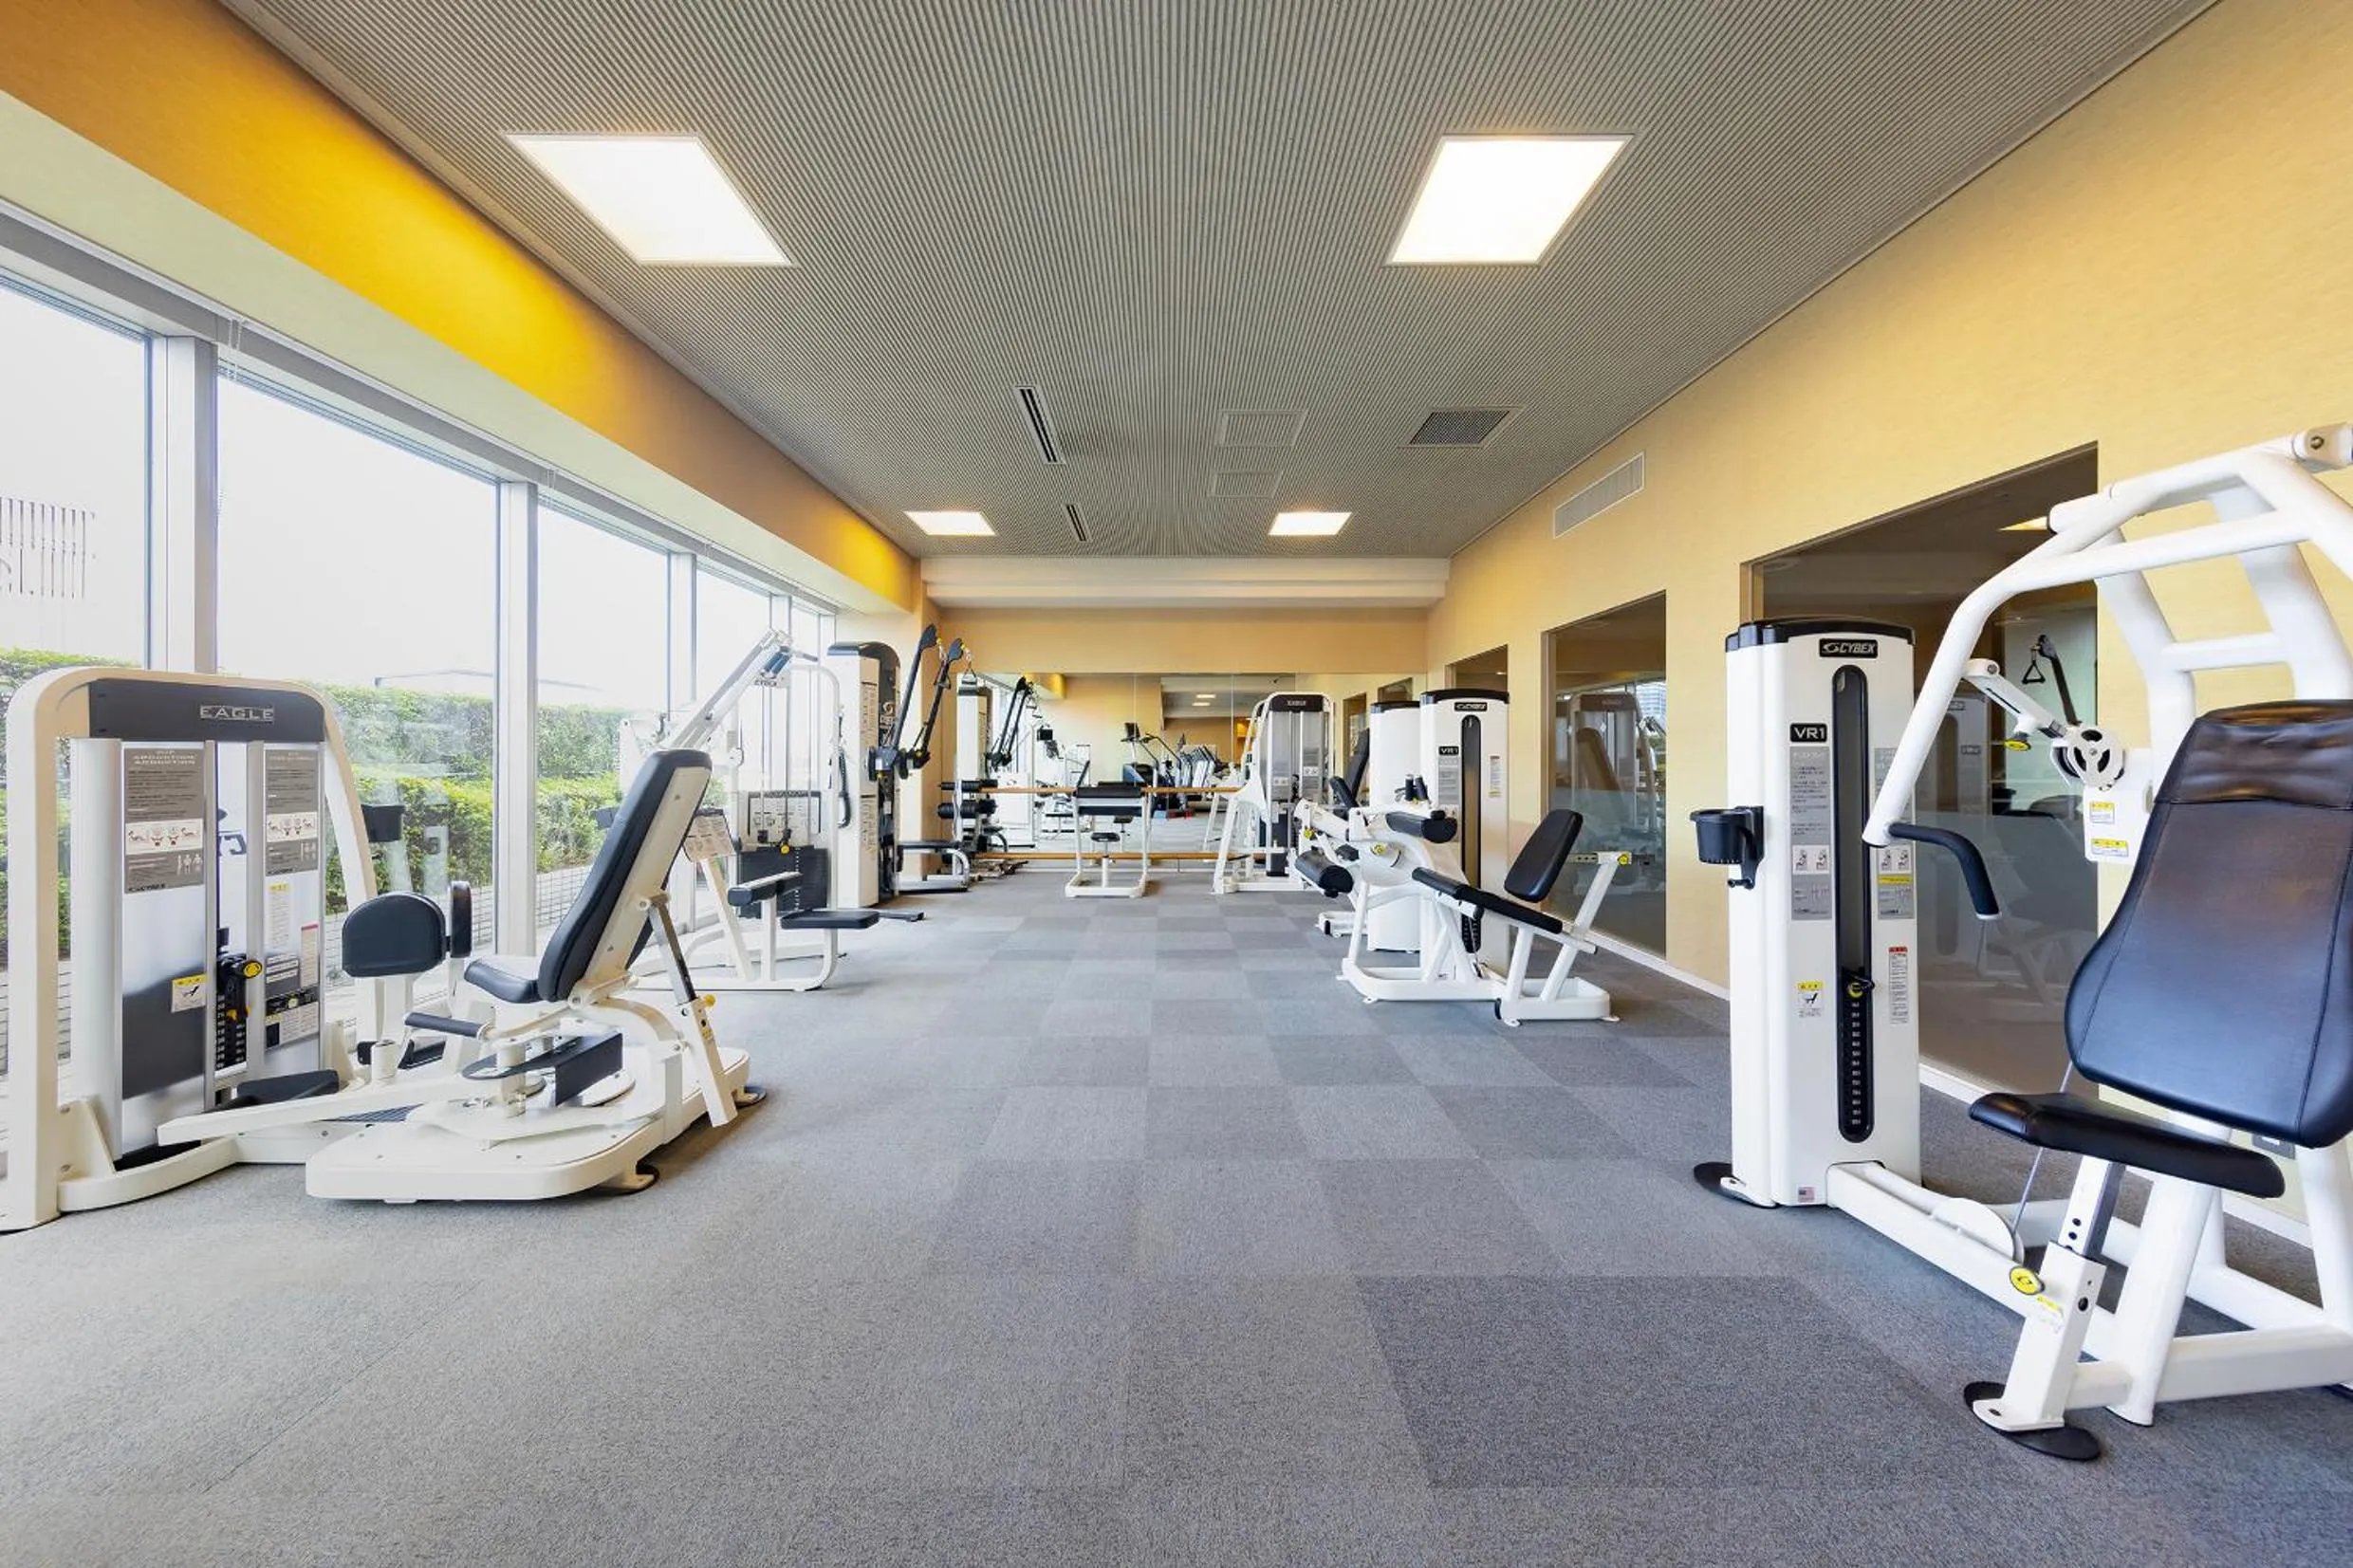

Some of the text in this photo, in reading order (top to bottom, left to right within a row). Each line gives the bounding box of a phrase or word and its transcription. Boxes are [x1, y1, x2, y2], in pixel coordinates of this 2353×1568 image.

[1839, 642, 1877, 655] CYBEX
[199, 706, 274, 721] EAGLE
[1793, 726, 1825, 739] VR1
